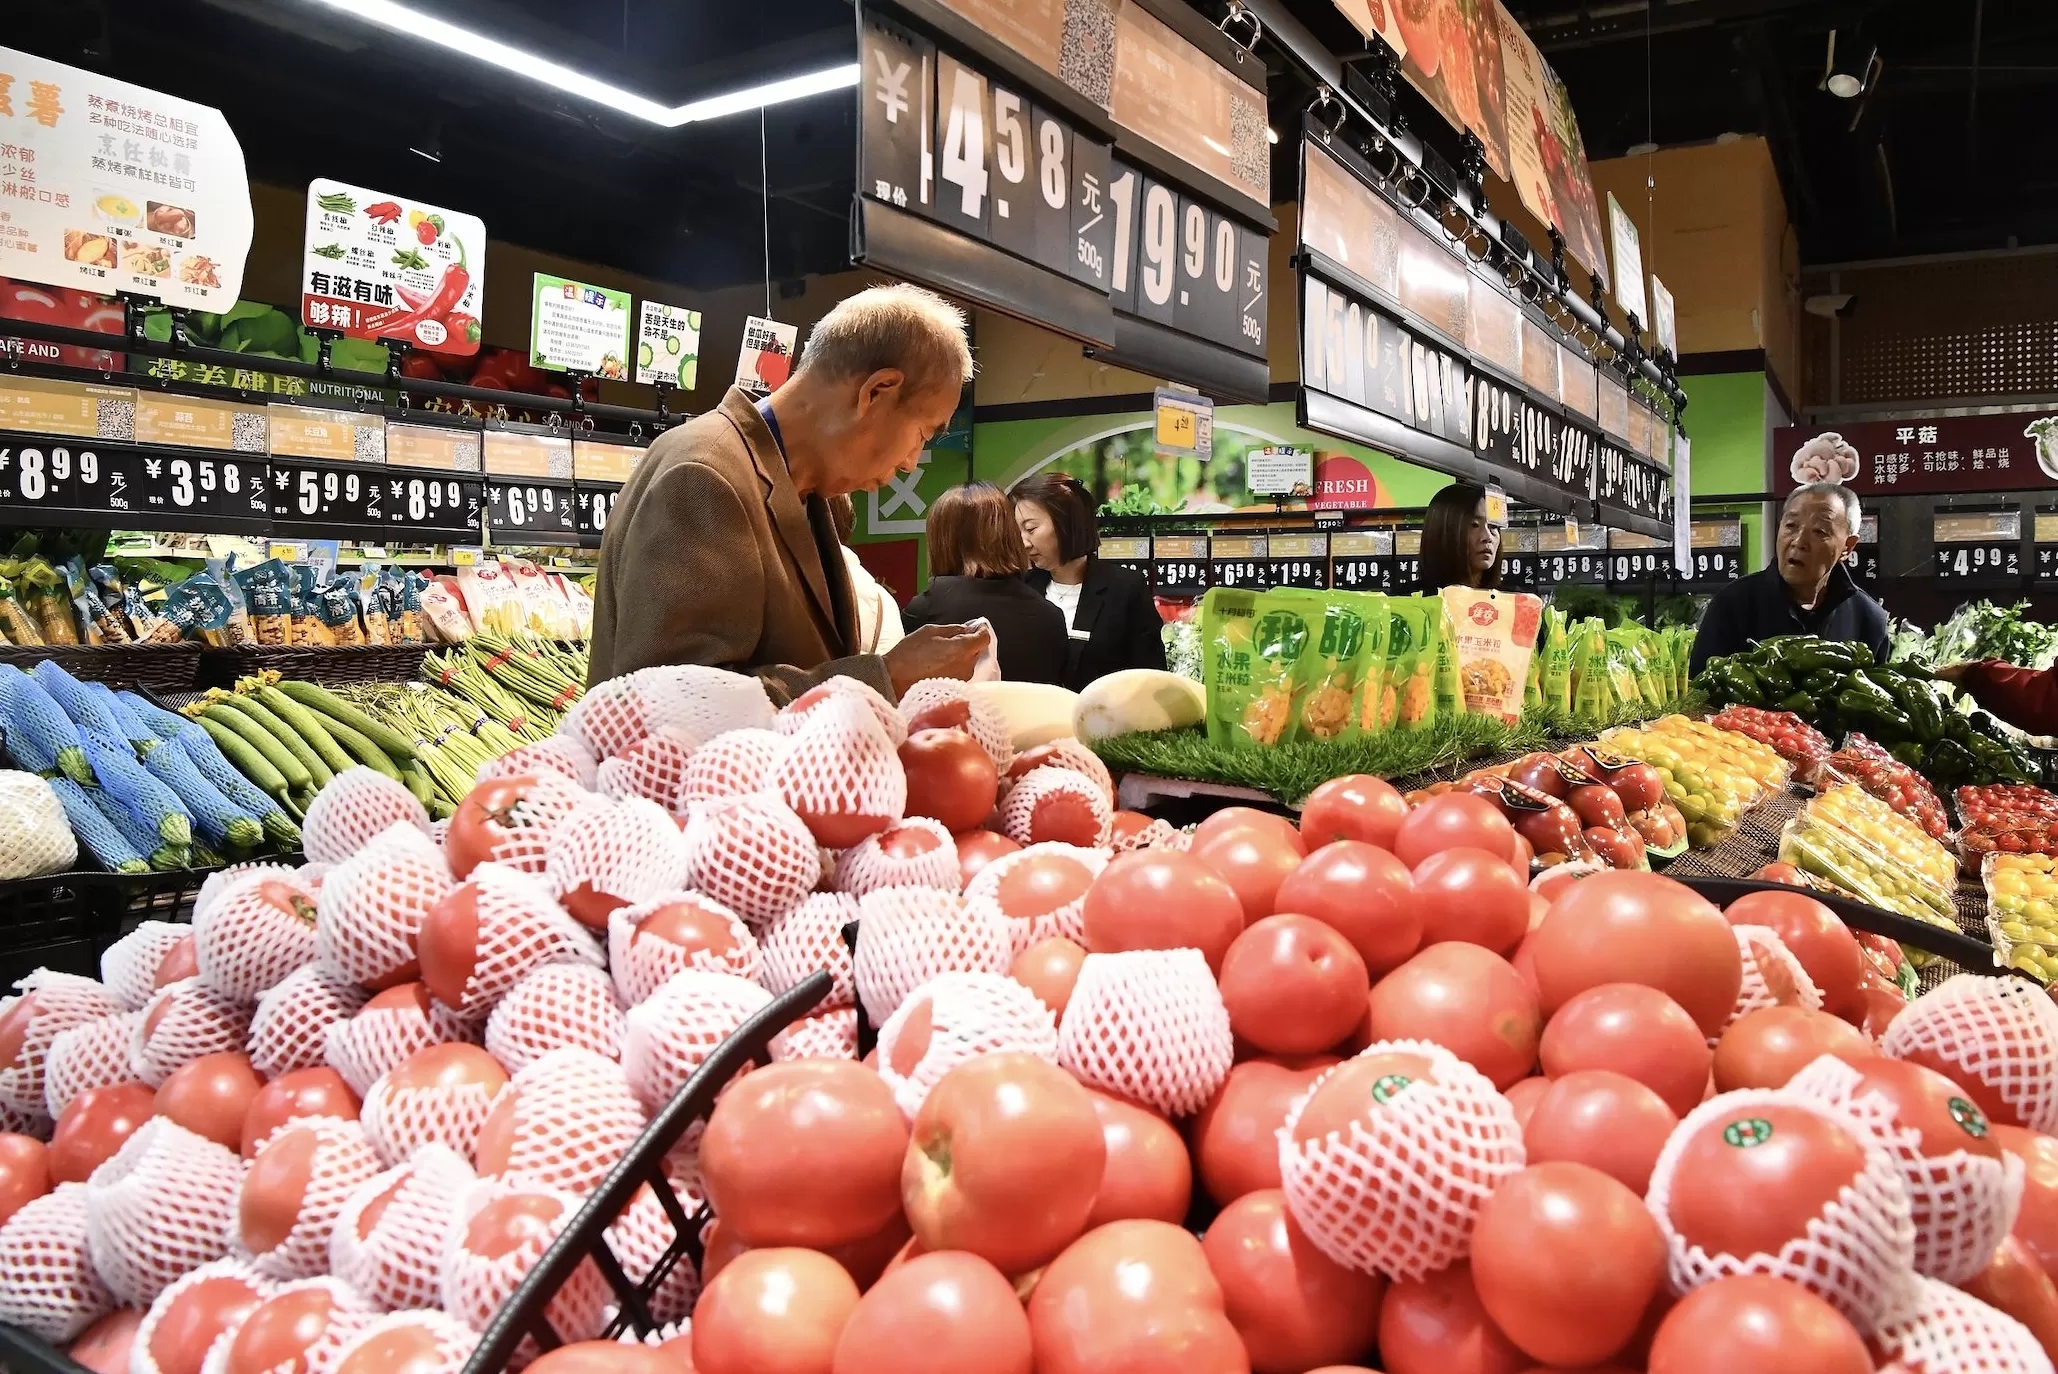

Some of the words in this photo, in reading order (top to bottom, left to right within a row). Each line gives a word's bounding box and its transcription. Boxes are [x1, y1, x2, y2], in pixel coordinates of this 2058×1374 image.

[89, 110, 198, 150] 多种吃法随心选择
[875, 179, 908, 208] 现价
[1109, 171, 1235, 306] 19.90
[310, 271, 393, 306] 有滋有味
[644, 313, 686, 331] 苦是天生的
[644, 325, 669, 341] 命不是
[28, 343, 60, 358] AND
[309, 382, 384, 402] NUTRITIONAL
[1896, 426, 1938, 445] 平菇
[1874, 474, 1898, 485] 炸等
[1314, 500, 1367, 510] VEGETABLE
